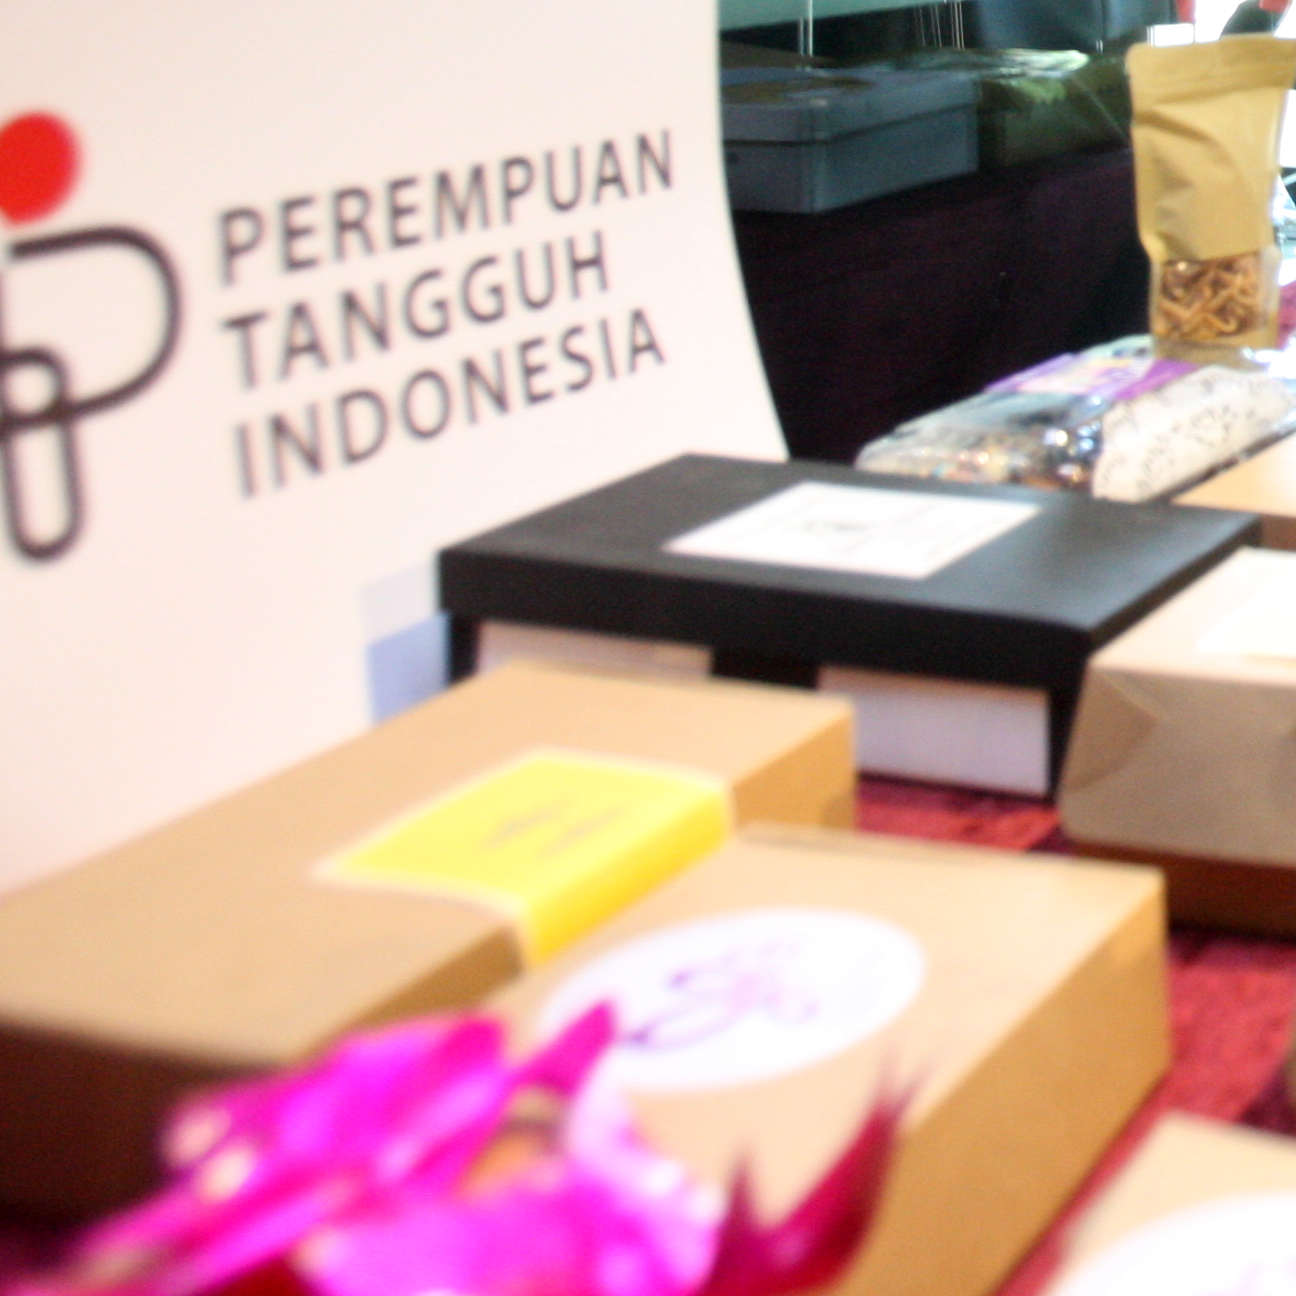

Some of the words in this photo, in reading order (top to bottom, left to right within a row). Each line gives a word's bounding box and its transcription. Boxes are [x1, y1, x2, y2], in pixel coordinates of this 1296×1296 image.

[216, 128, 676, 289] PEREMPUAN
[221, 228, 612, 391] TANGGUH
[231, 306, 668, 500] INDONESIA
